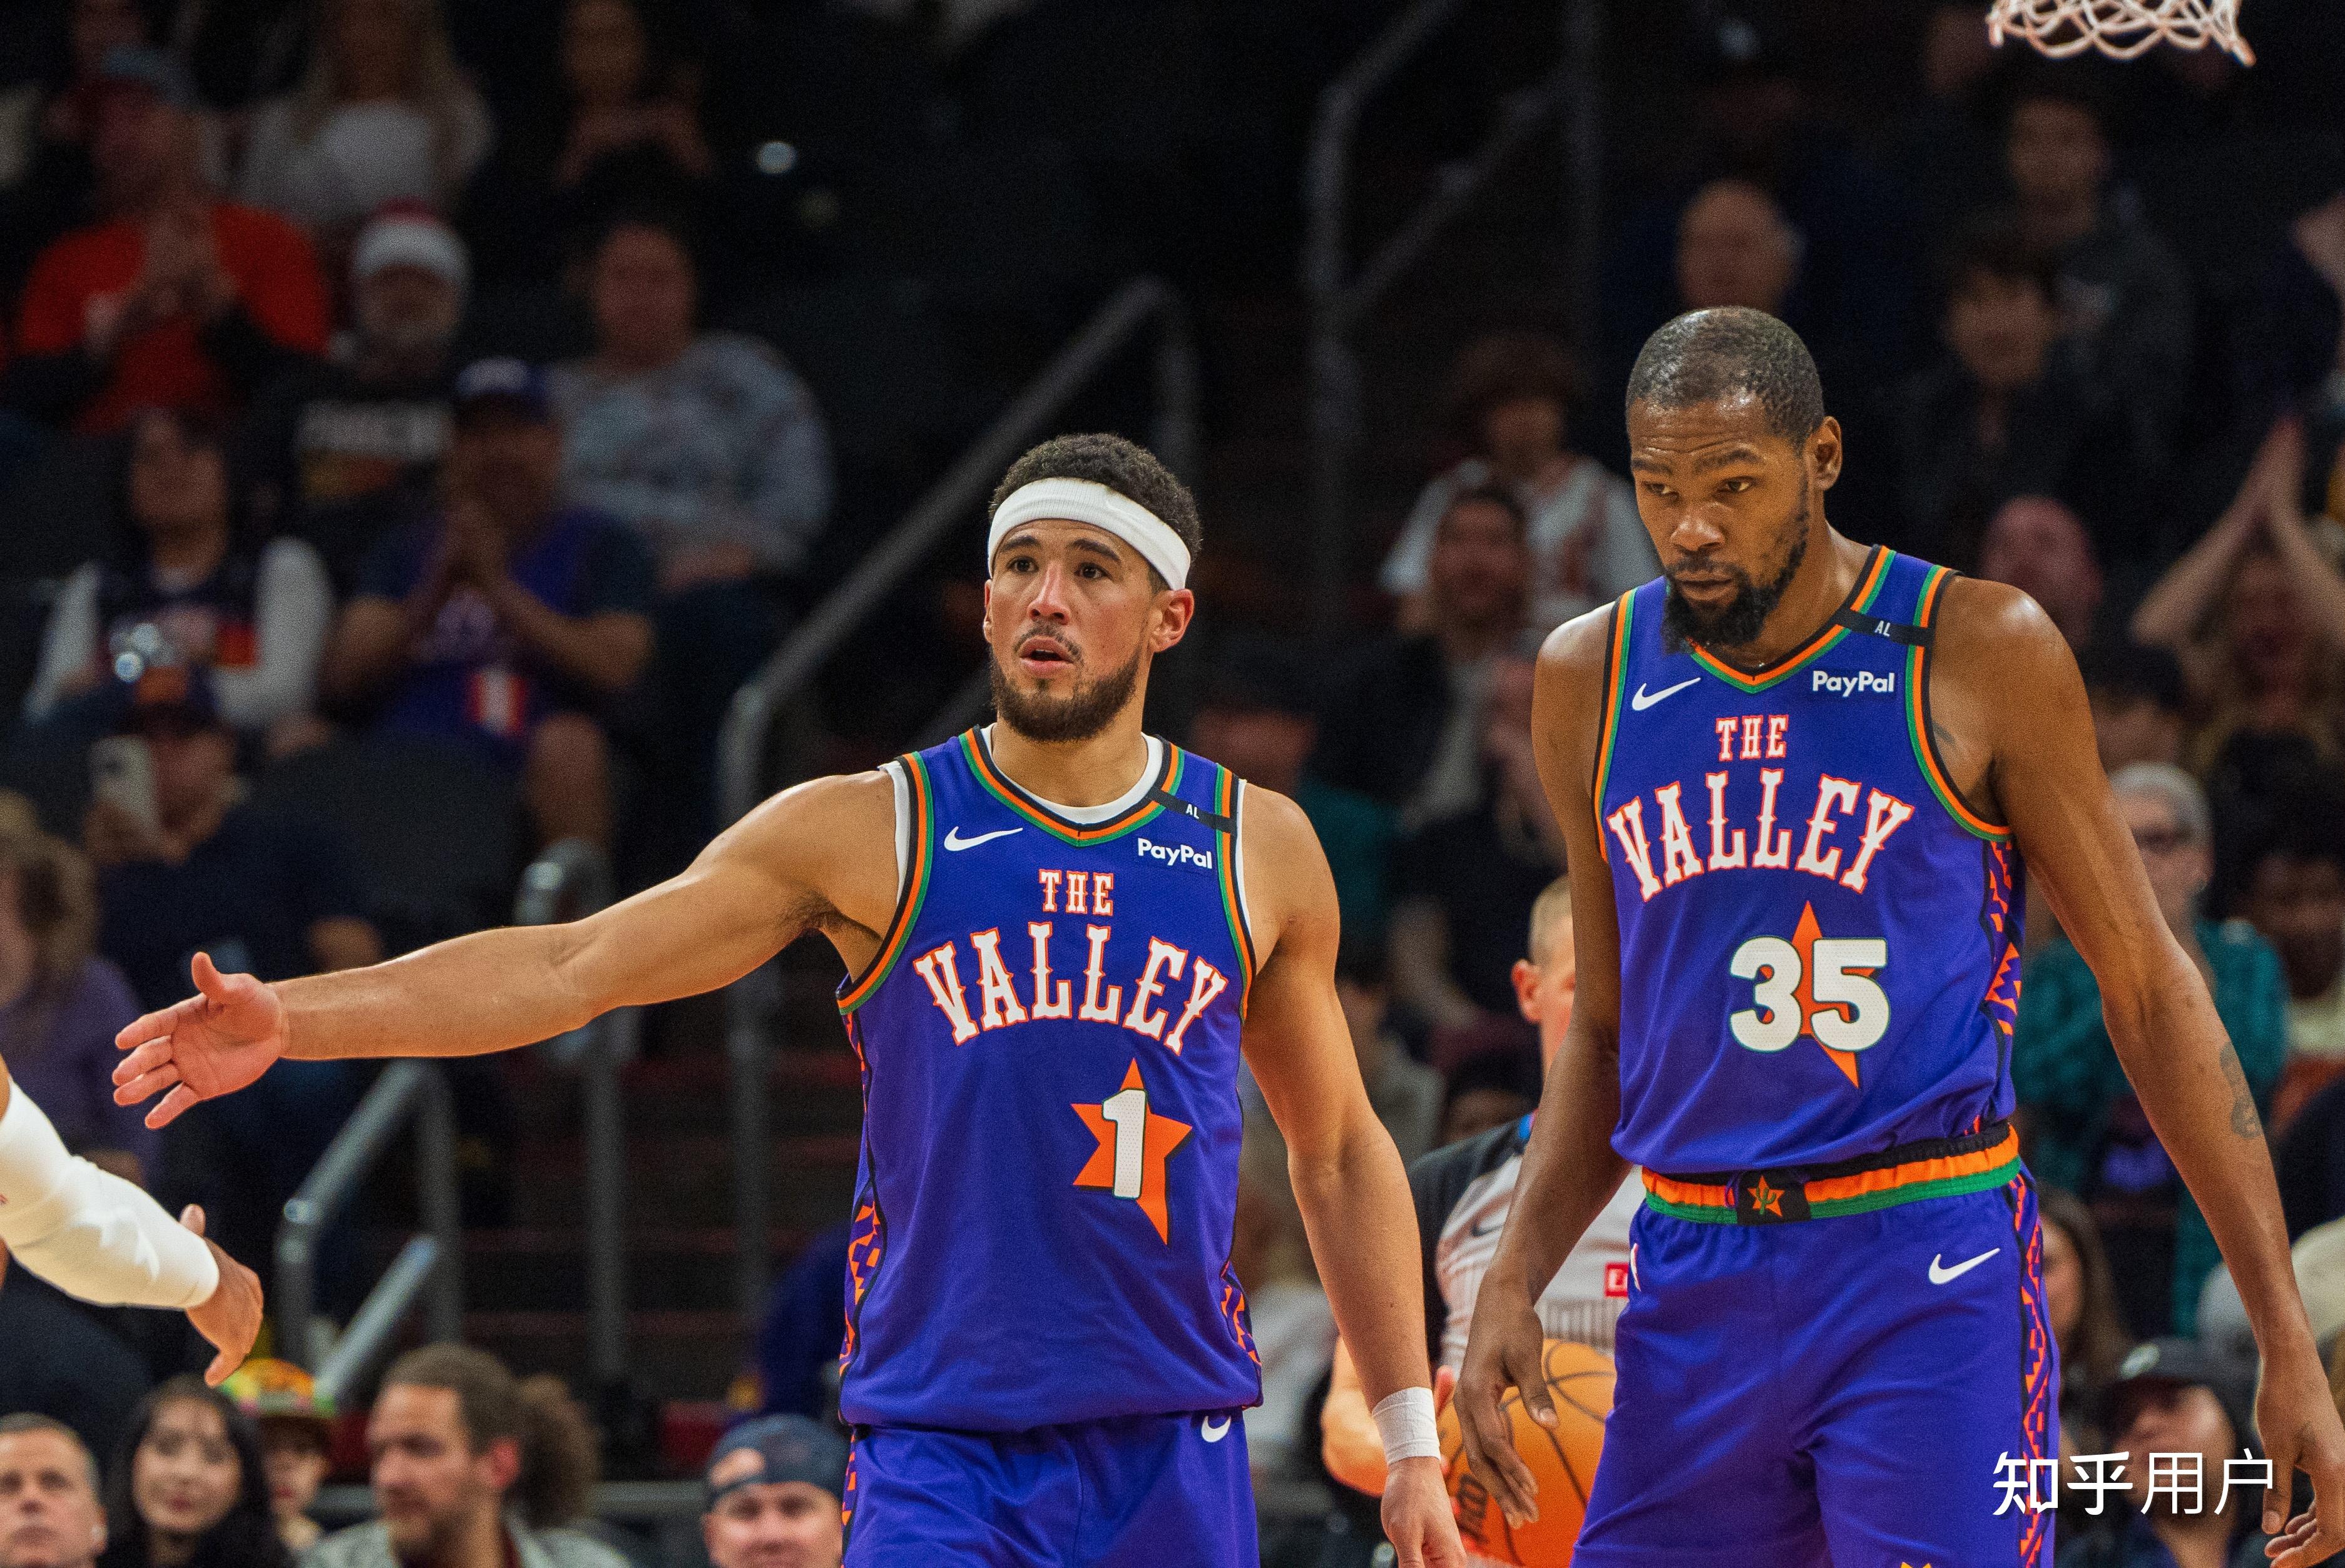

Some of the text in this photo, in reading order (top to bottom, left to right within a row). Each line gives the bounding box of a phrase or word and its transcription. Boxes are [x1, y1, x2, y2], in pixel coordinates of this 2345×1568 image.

[1875, 620, 1891, 637] AL
[1812, 671, 1894, 697] PayPal
[1716, 715, 1789, 761] THE
[1185, 804, 1200, 819] AL
[1138, 838, 1213, 869] PayPal
[1607, 768, 1914, 902] VALLEY
[1039, 869, 1114, 915] THE
[914, 921, 1227, 1056] VALLEY
[1730, 936, 1890, 1052] 35
[1103, 1089, 1148, 1199] 1
